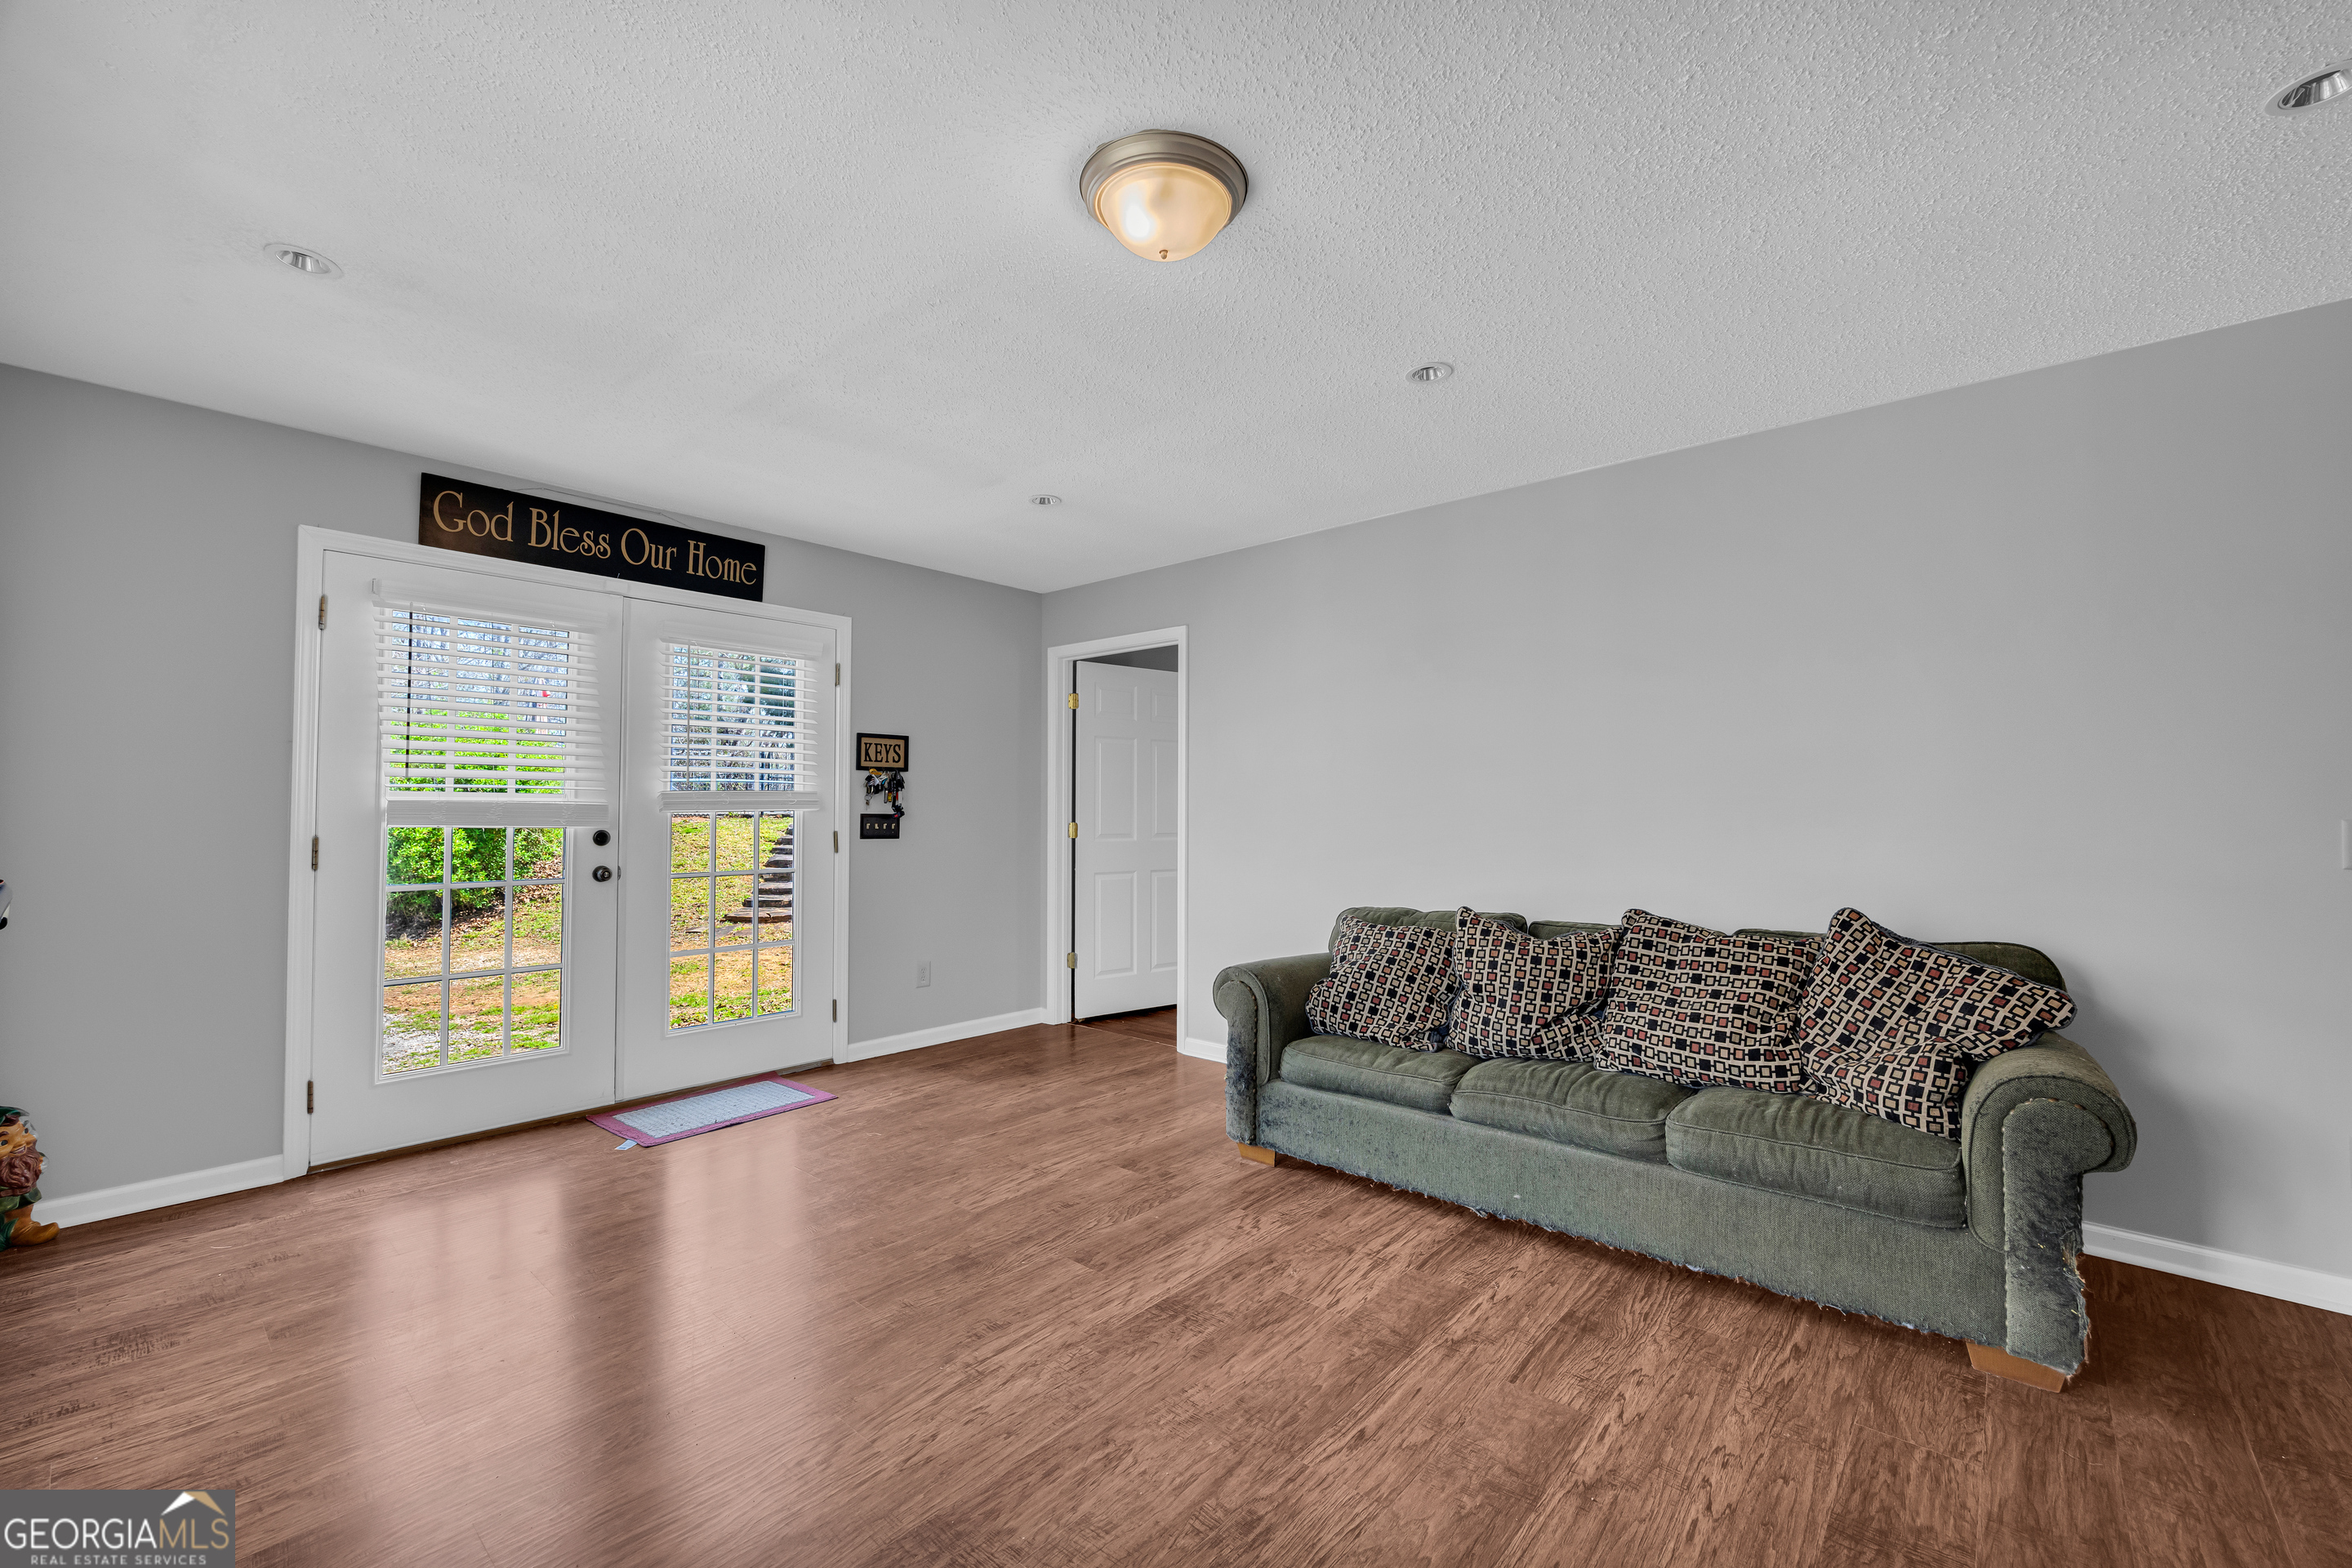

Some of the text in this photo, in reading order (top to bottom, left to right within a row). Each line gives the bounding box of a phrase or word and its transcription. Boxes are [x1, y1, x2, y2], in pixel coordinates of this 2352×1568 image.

[433, 490, 757, 585] God Bless Our Home
[863, 742, 902, 764] KEYS
